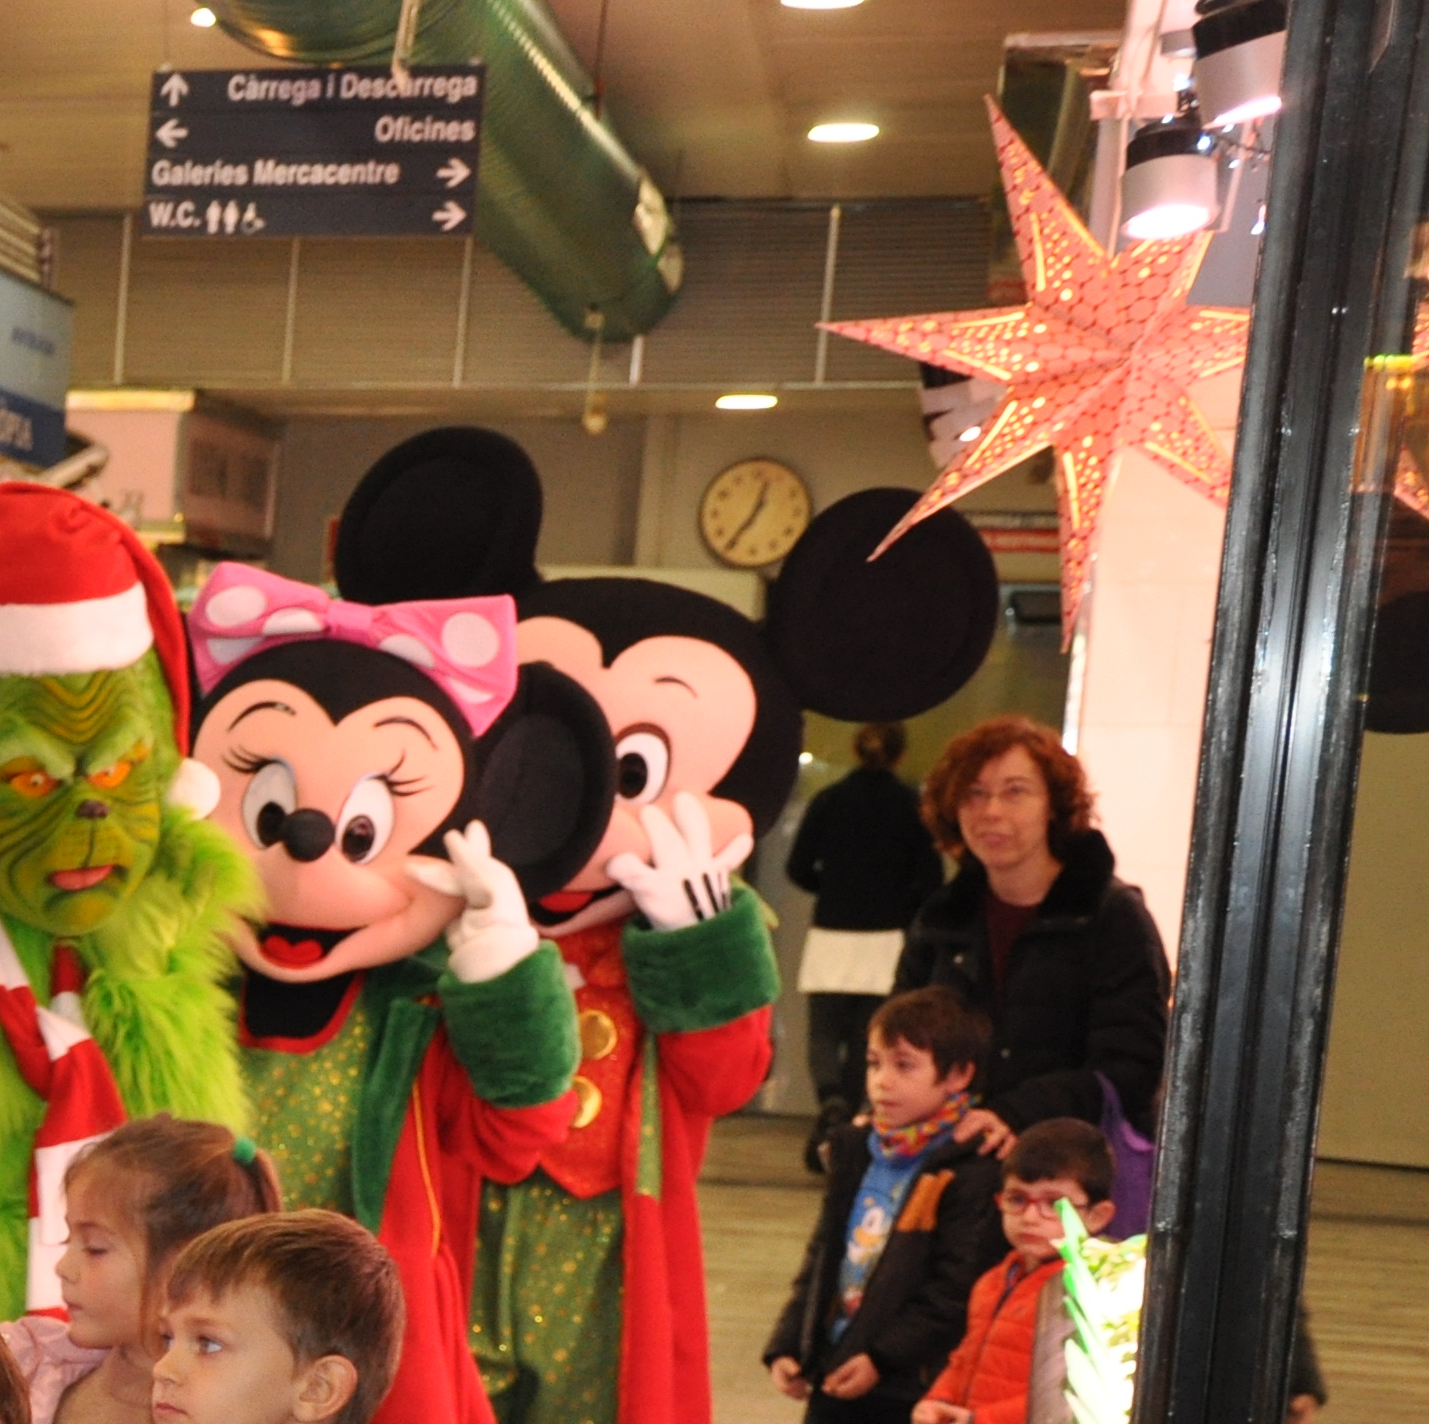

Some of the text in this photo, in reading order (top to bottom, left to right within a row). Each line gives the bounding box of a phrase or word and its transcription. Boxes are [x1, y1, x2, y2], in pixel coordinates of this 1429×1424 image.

[227, 73, 321, 105] Càrrega
[327, 74, 334, 98] i
[374, 115, 476, 143] Oficines
[151, 159, 401, 186] Galeries Mercacentre
[148, 201, 201, 228] W.C.
